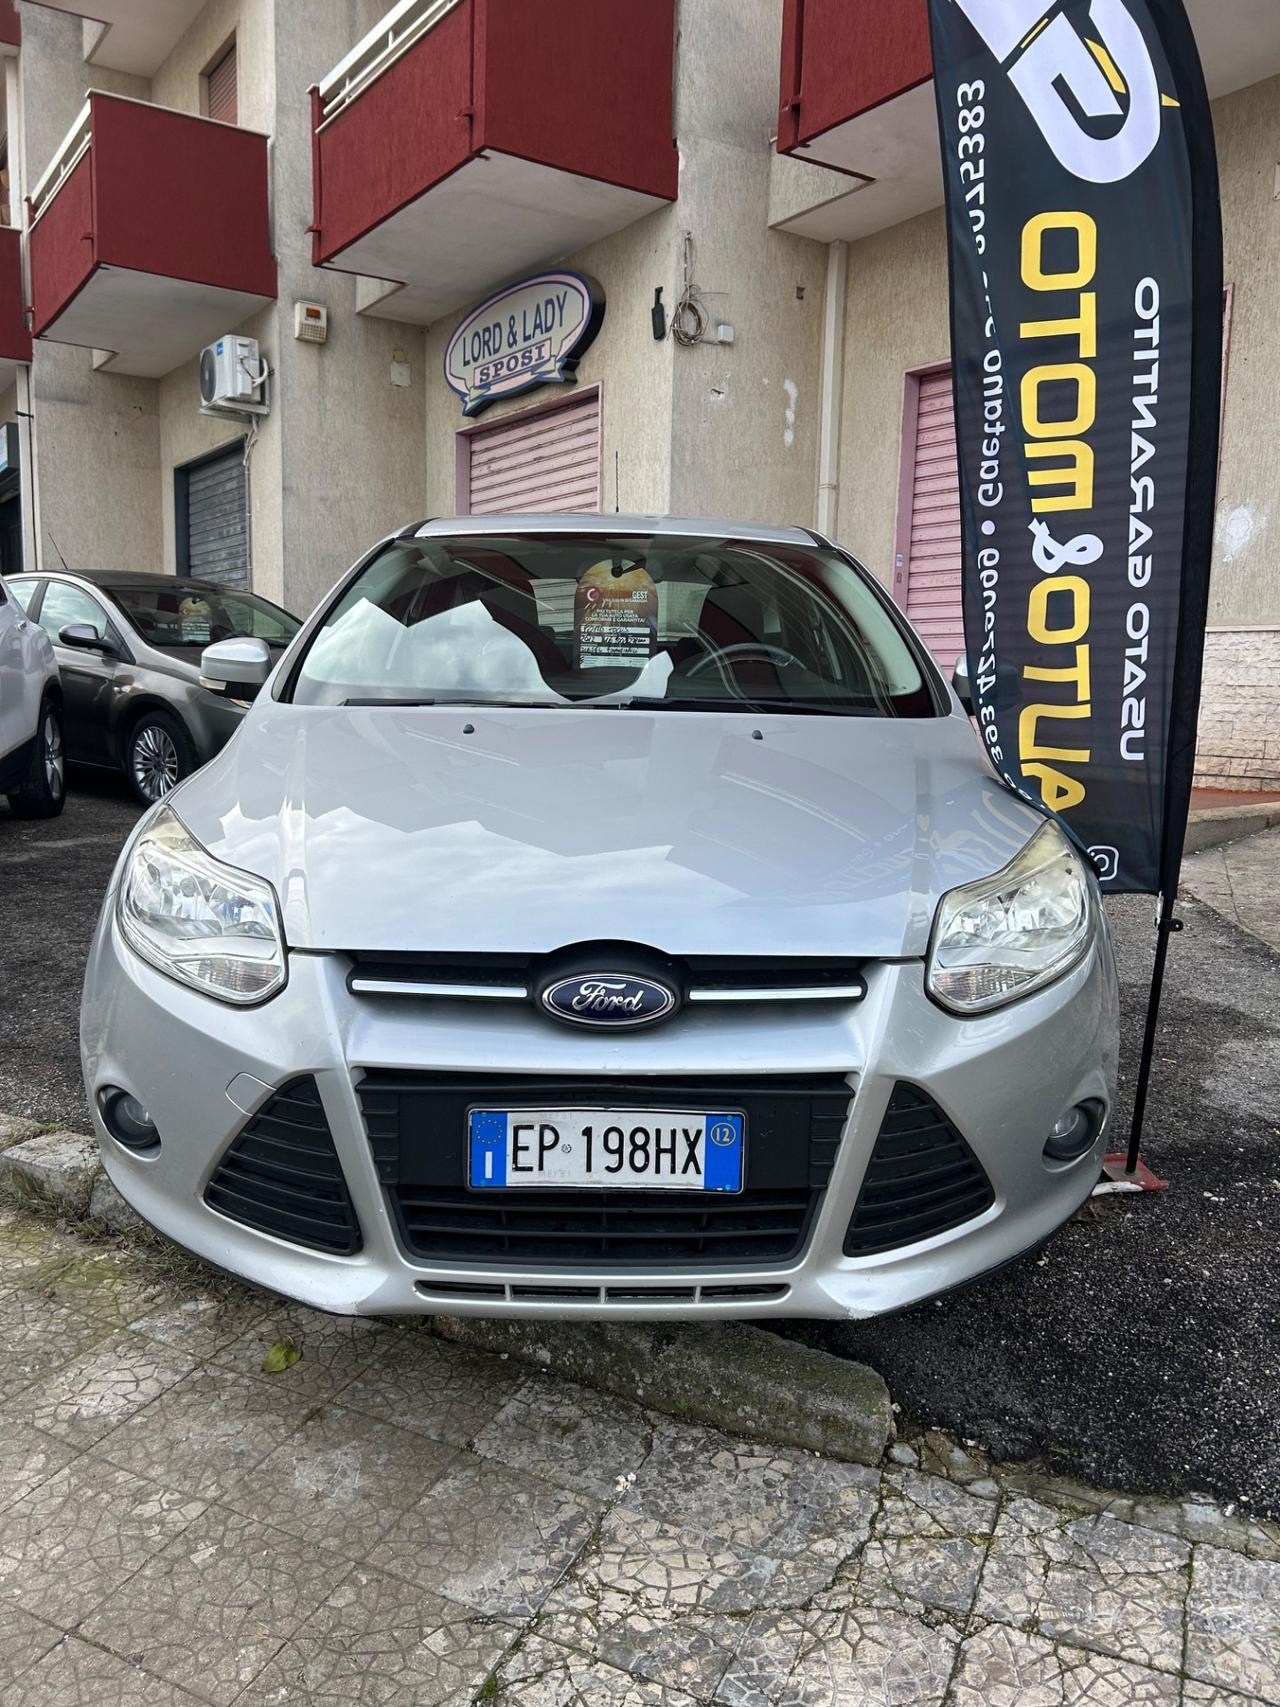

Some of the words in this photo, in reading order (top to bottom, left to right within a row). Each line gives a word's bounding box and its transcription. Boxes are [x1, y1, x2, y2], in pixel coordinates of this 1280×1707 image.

[463, 322, 503, 368] LORD
[507, 315, 518, 349] &
[523, 290, 568, 343] LADY
[479, 344, 546, 384] SPOSI
[572, 981, 644, 1012] Ford
[511, 1124, 560, 1172] EP
[581, 1126, 703, 1175] 198HX
[716, 1127, 730, 1142] 12
